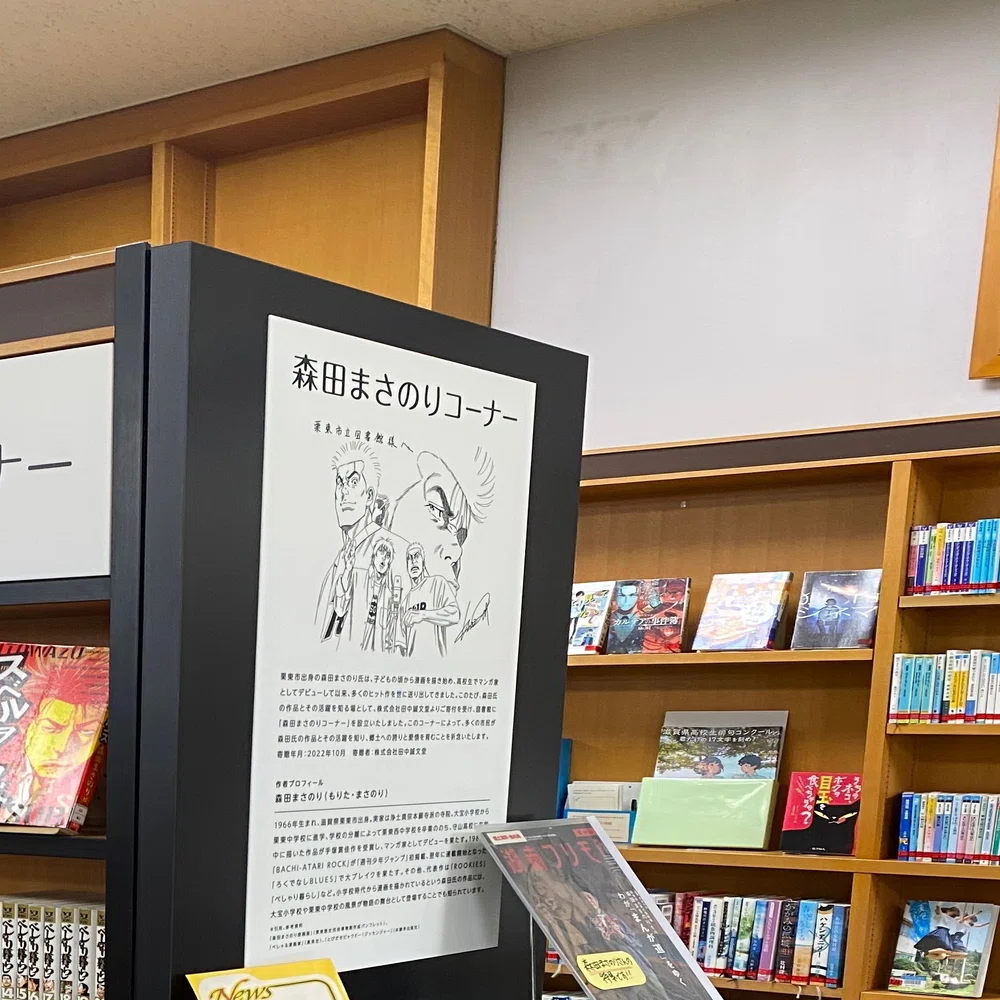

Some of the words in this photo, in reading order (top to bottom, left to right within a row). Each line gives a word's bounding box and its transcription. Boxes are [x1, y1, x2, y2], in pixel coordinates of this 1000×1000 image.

[292, 354, 518, 427] 森田まさのりコーナー
[2, 987, 13, 999] 14
[17, 987, 28, 1000] 15
